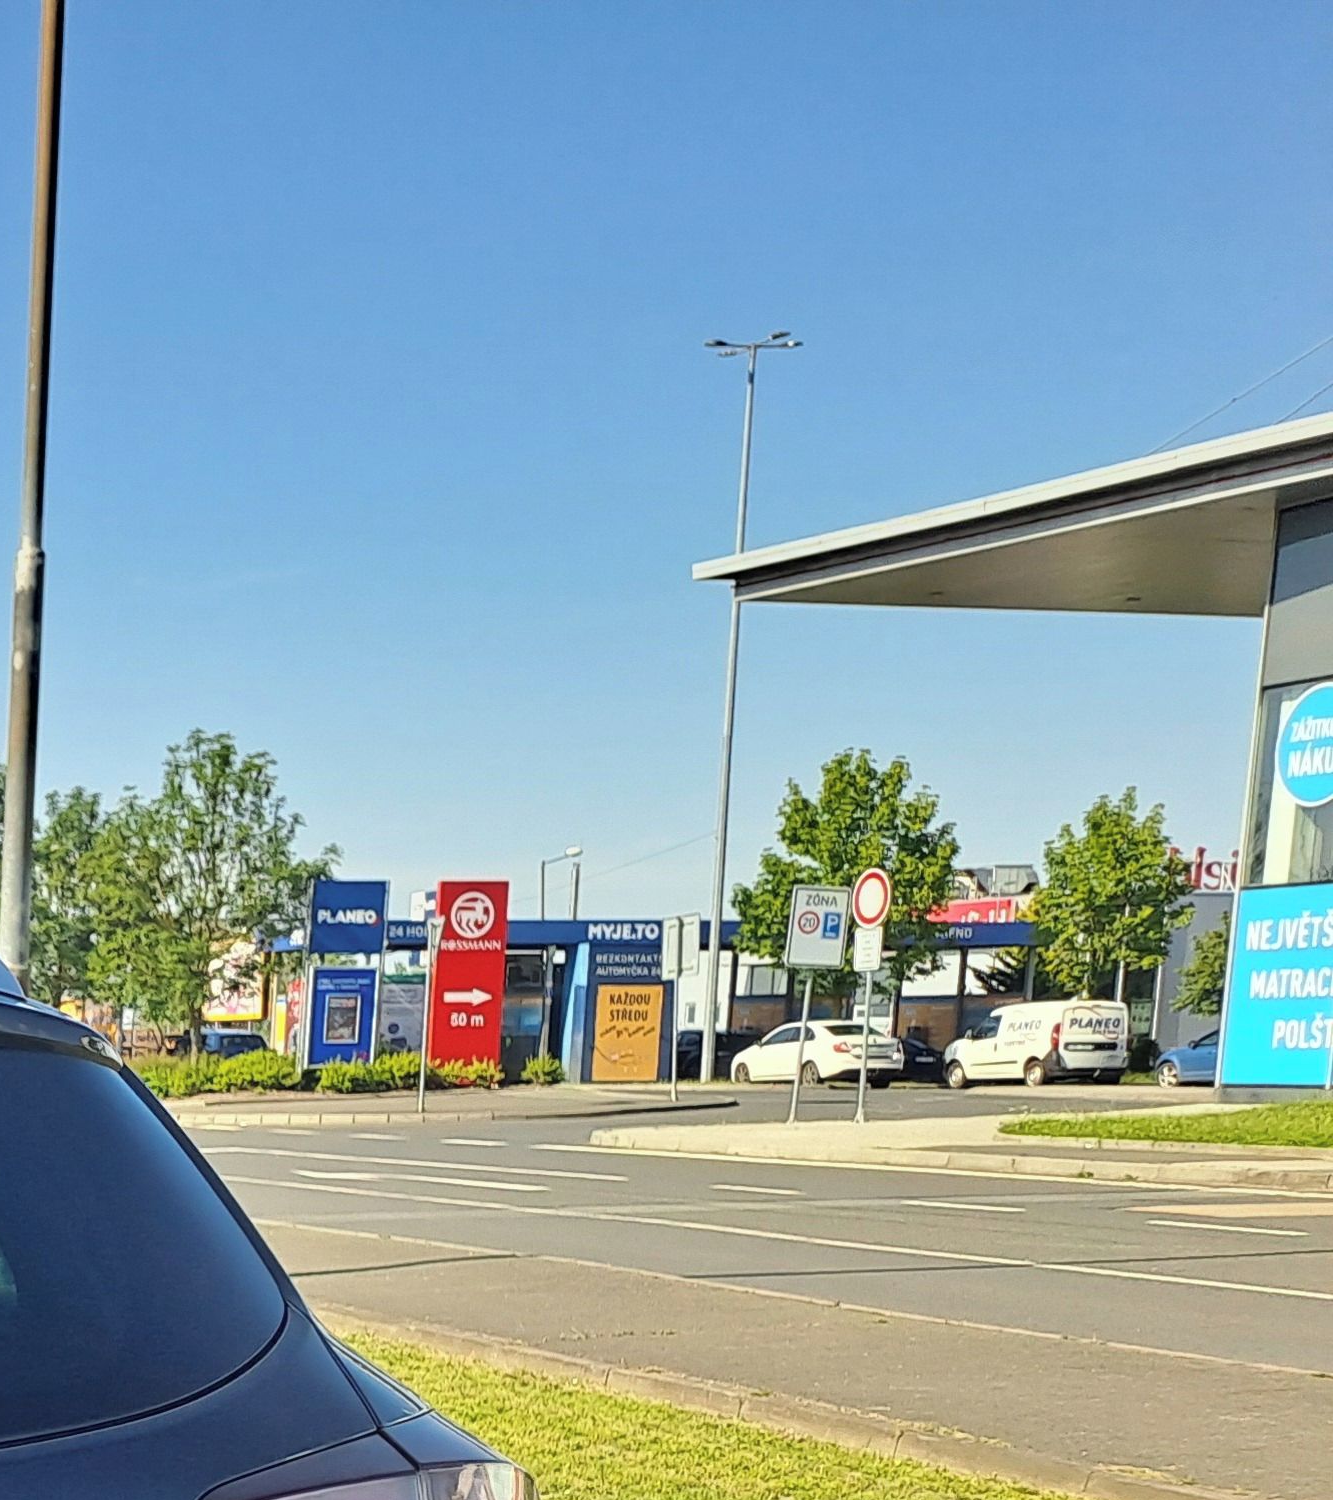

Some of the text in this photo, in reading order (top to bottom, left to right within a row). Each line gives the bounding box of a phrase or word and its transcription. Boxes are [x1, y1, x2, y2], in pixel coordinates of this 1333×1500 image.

[317, 910, 377, 925] PLANEO
[803, 918, 815, 928] 20
[440, 940, 502, 951] ROSSMANN
[609, 991, 651, 1006] KAŽDOU
[470, 1015, 485, 1027] m
[608, 1008, 648, 1022] STŘEDU
[1069, 1017, 1121, 1029] PLANEO
